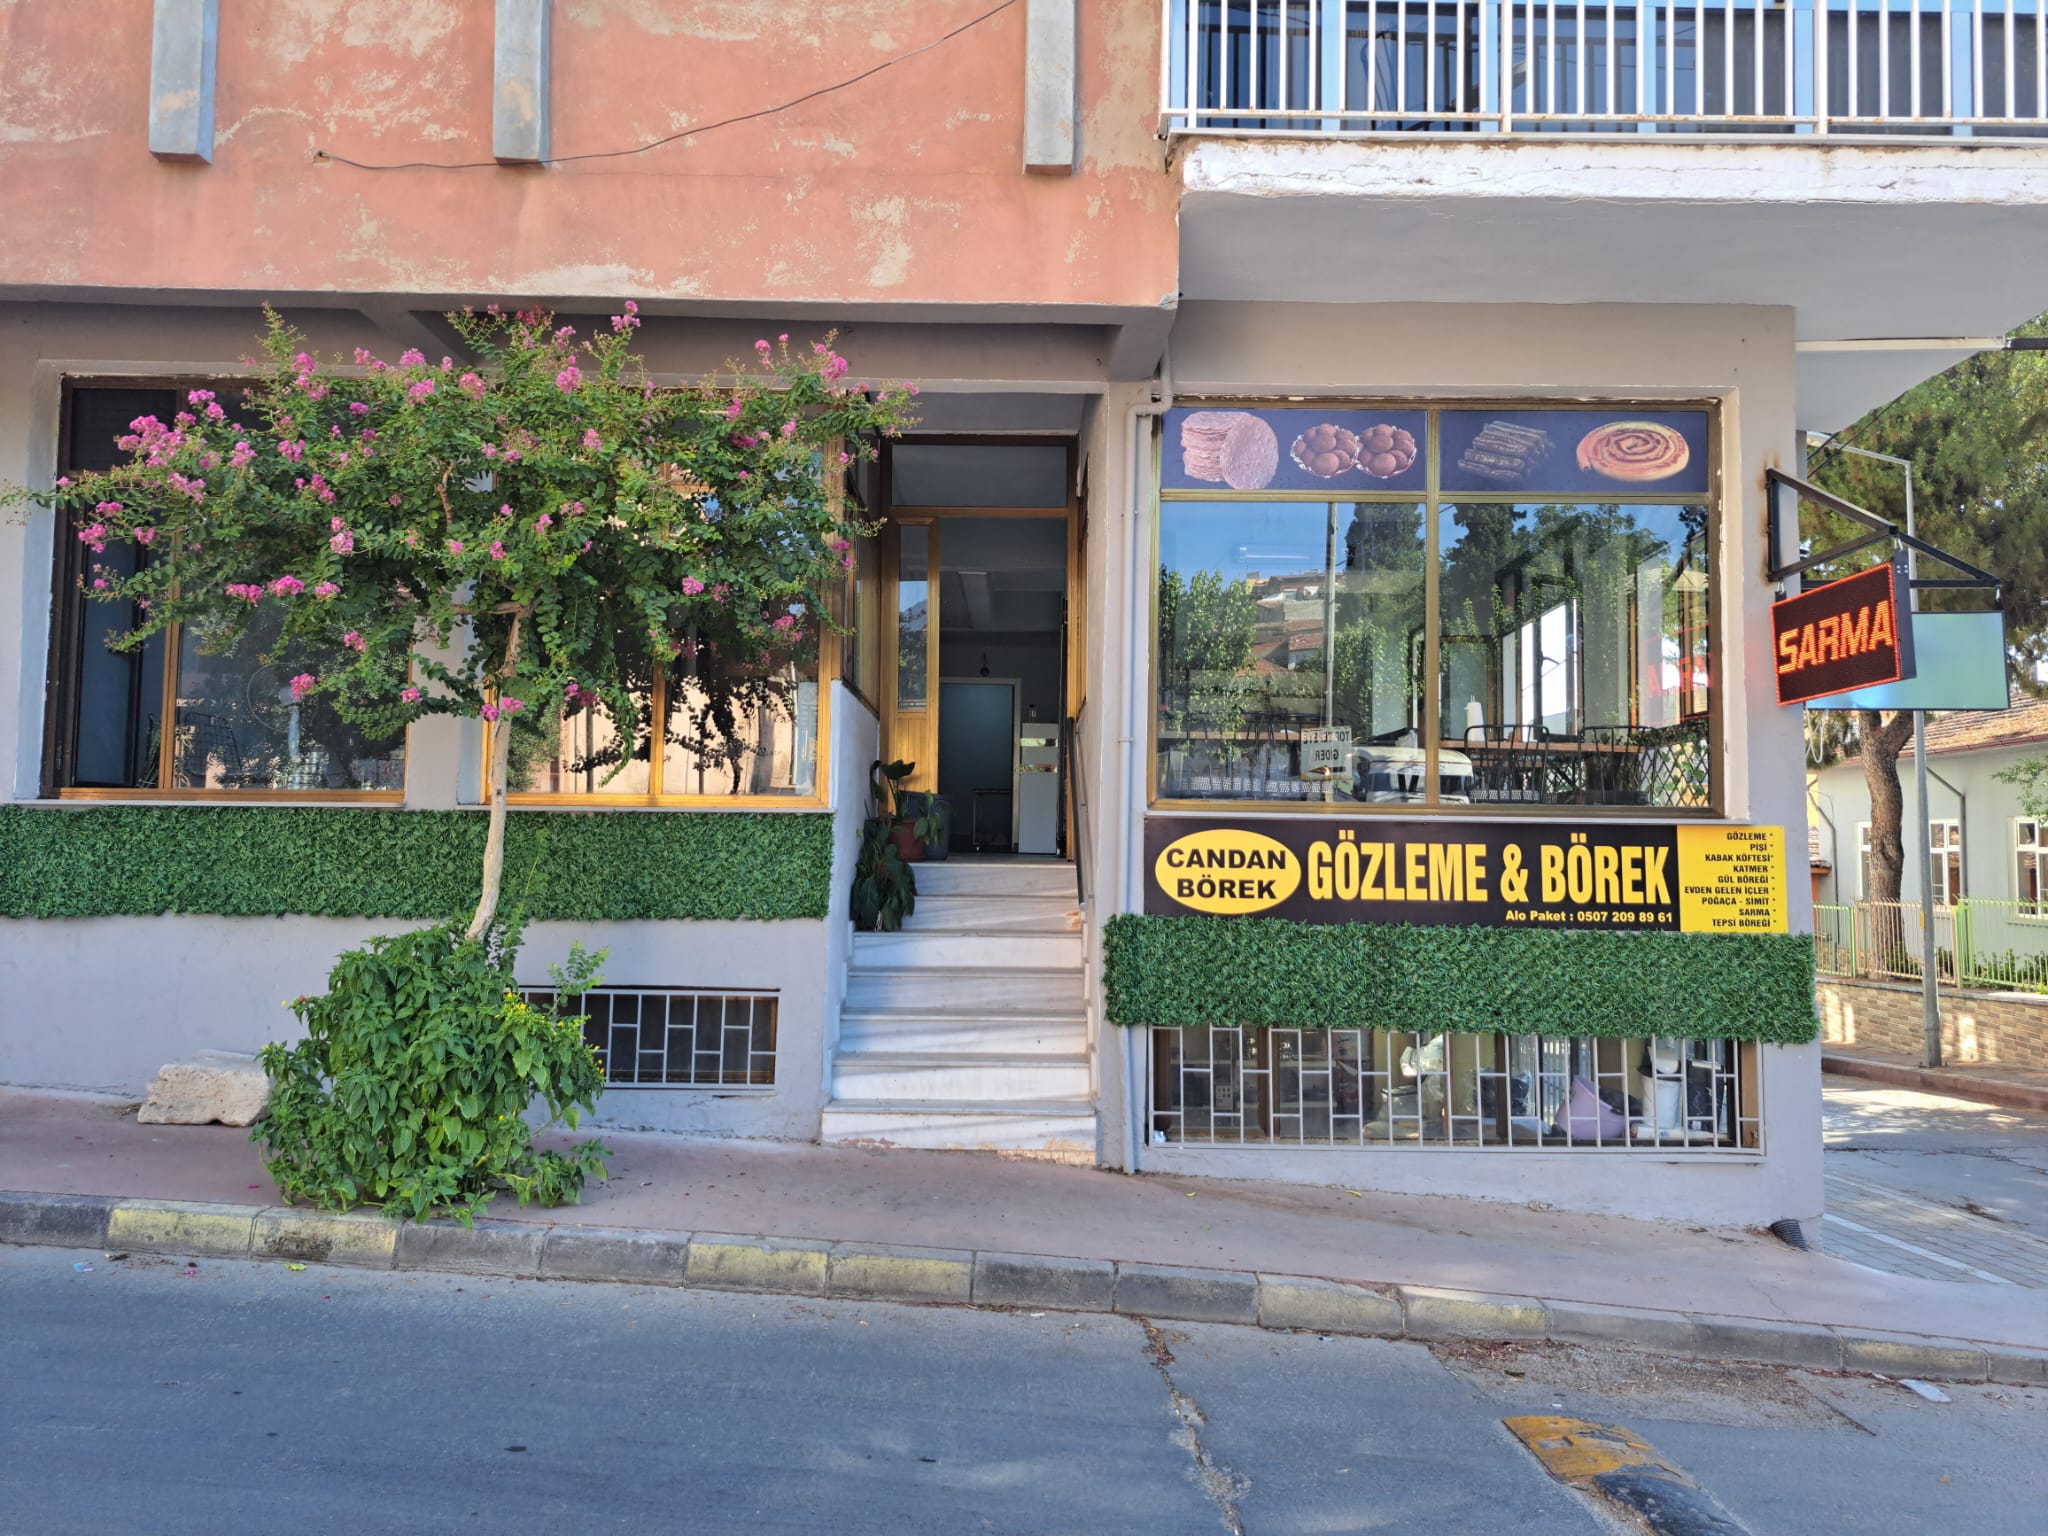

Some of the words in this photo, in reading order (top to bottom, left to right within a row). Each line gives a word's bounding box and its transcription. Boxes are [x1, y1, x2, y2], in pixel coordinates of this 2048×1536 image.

[1778, 600, 1892, 674] SARMA
[1727, 832, 1767, 840] GÖZLEME
[1750, 843, 1767, 852] PİŞİ
[1166, 848, 1286, 870] CANDAN
[1736, 854, 1770, 862] KÖFTESİ
[1308, 830, 1488, 902] GÖZLEME
[1500, 843, 1529, 903] &
[1540, 833, 1671, 904] BÖREK
[1718, 874, 1734, 883] GÜL
[1738, 874, 1768, 883] BÖREĞİ
[1177, 874, 1276, 899] BÖREK
[1714, 886, 1742, 894] GELEN
[1745, 886, 1768, 896] İÇLER
[1702, 896, 1736, 906] POĞAÇA
[1746, 896, 1769, 905] SİMİT
[1506, 910, 1526, 921] Alo
[1530, 911, 1566, 922] Paket
[1578, 912, 1608, 922] 0507
[1612, 912, 1635, 922] 209
[1639, 912, 1654, 922] 89
[1658, 912, 1672, 922] 61
[1712, 918, 1736, 927] TEPSİ
[1739, 918, 1770, 927] BÖREĞİ
